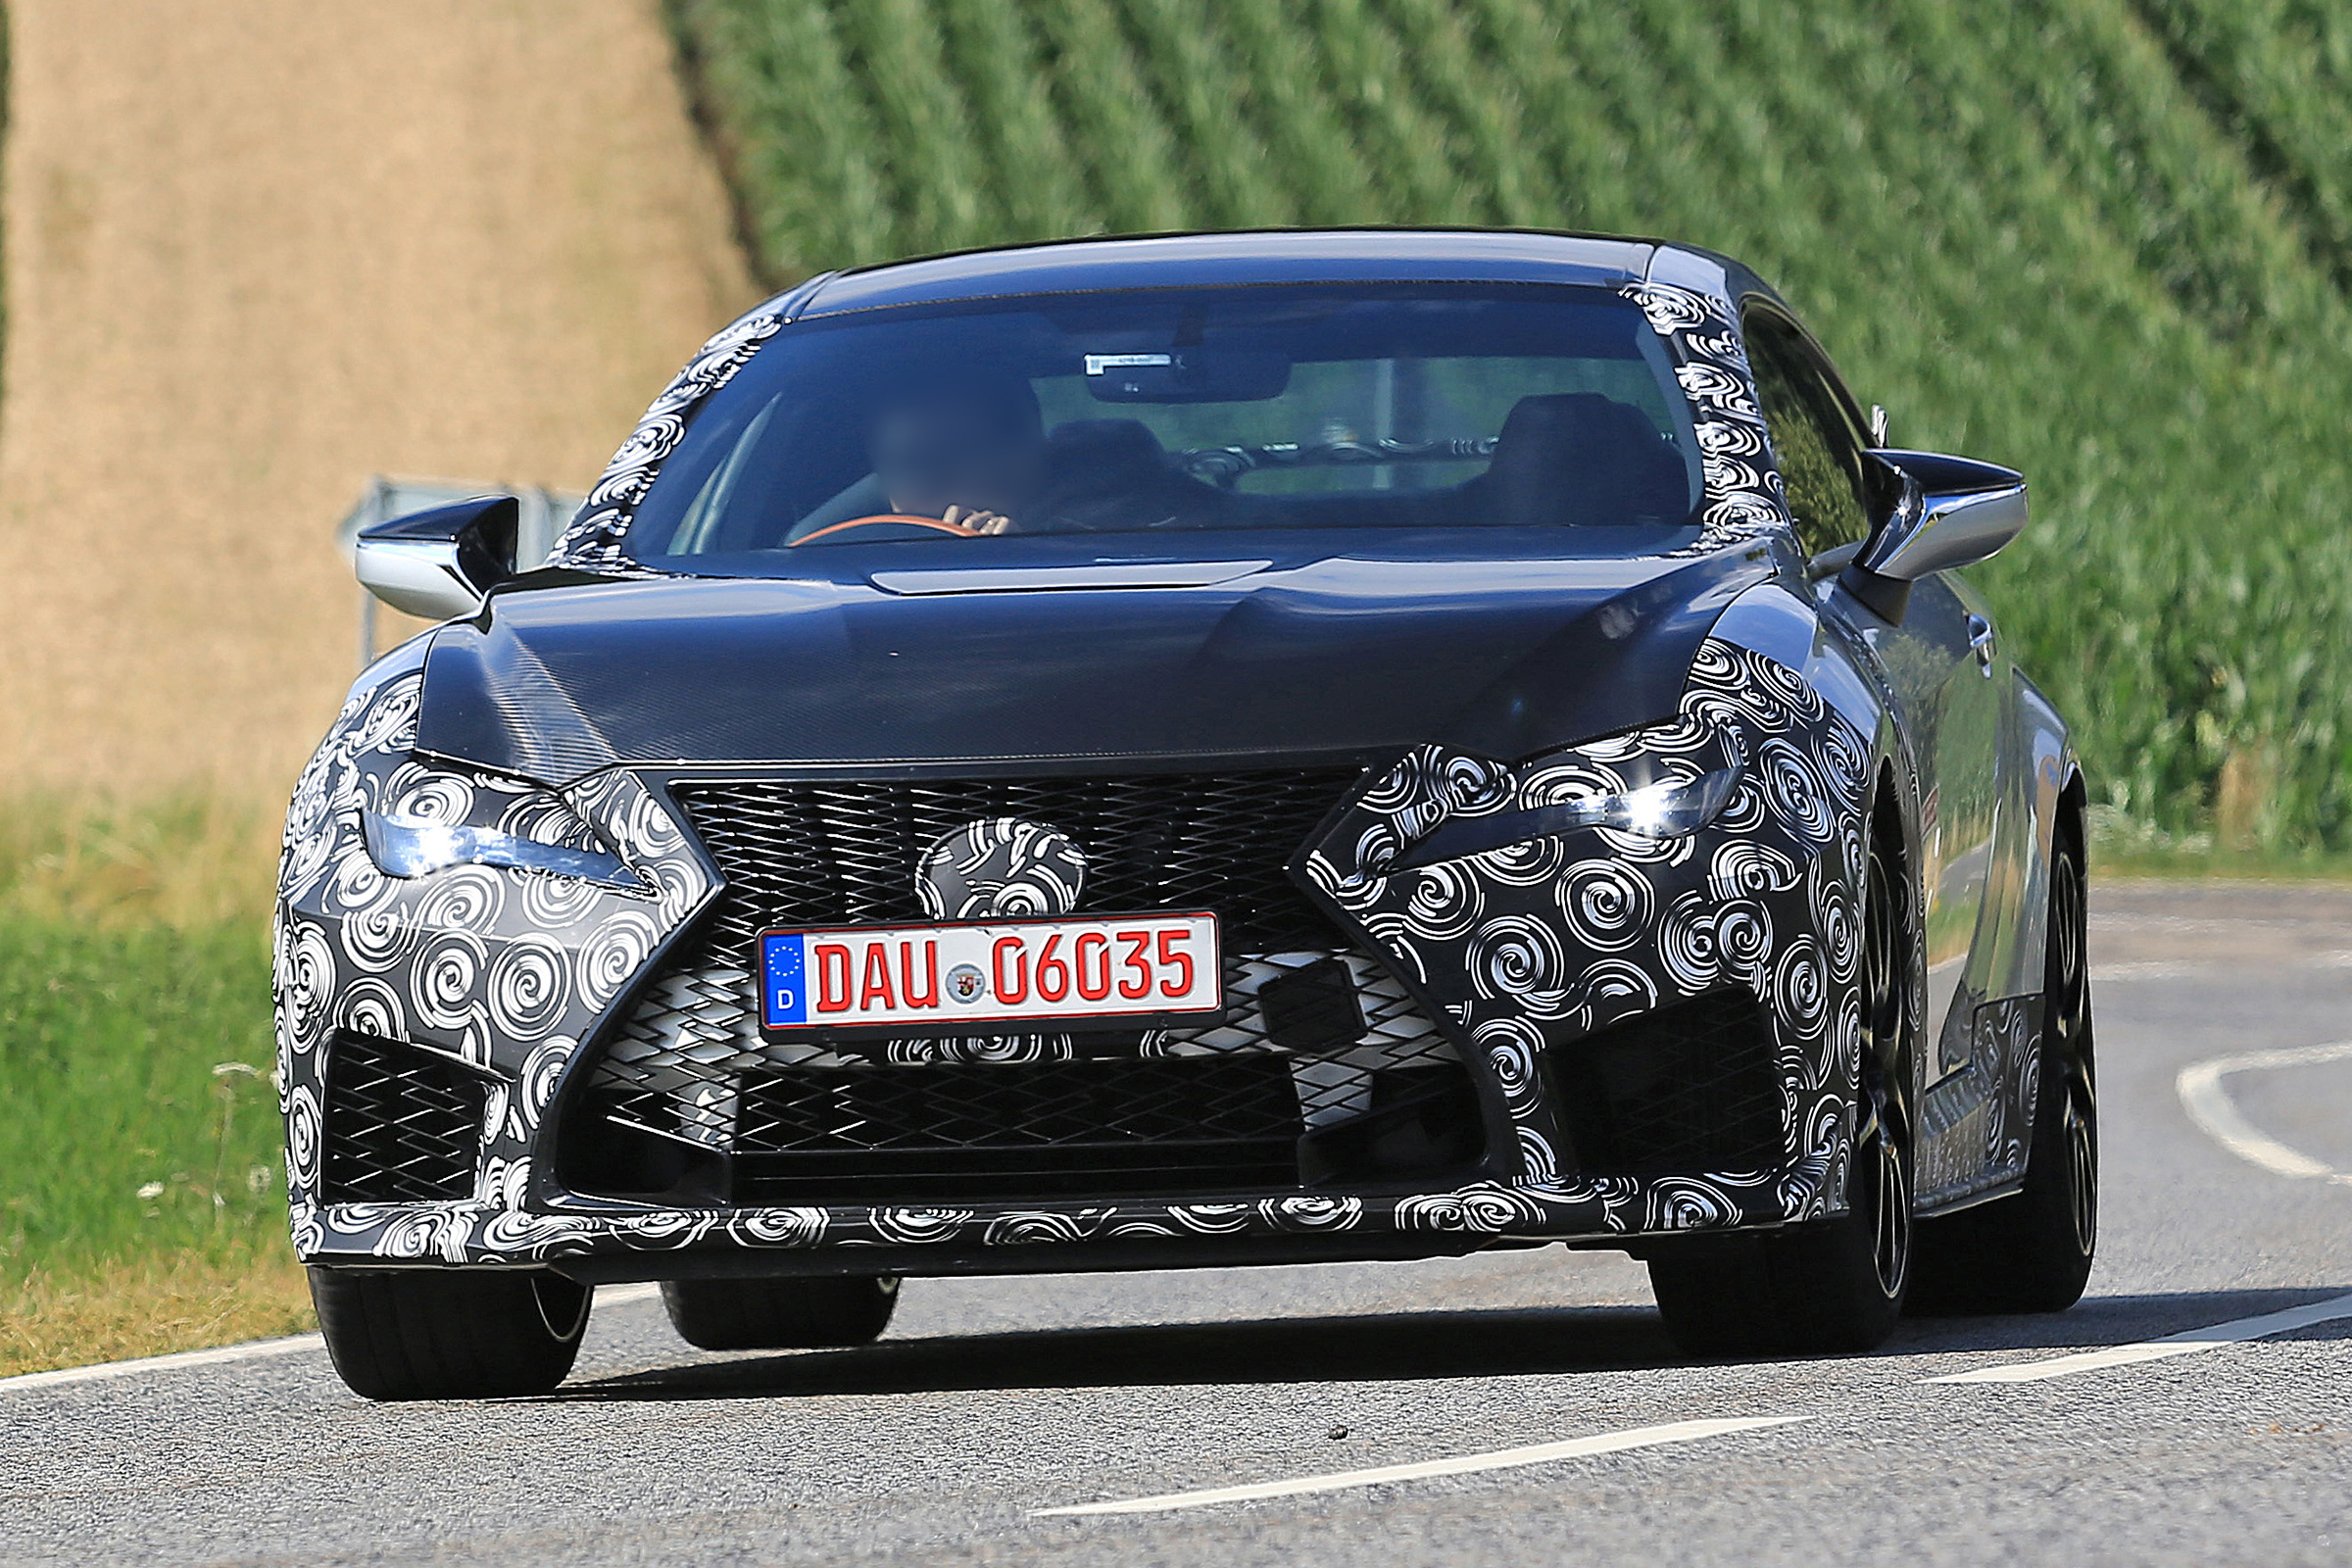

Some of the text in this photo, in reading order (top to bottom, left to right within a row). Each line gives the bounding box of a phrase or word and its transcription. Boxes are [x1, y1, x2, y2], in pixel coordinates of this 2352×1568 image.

[815, 929, 1194, 1011] DAU 06035
[777, 990, 794, 1009] D
